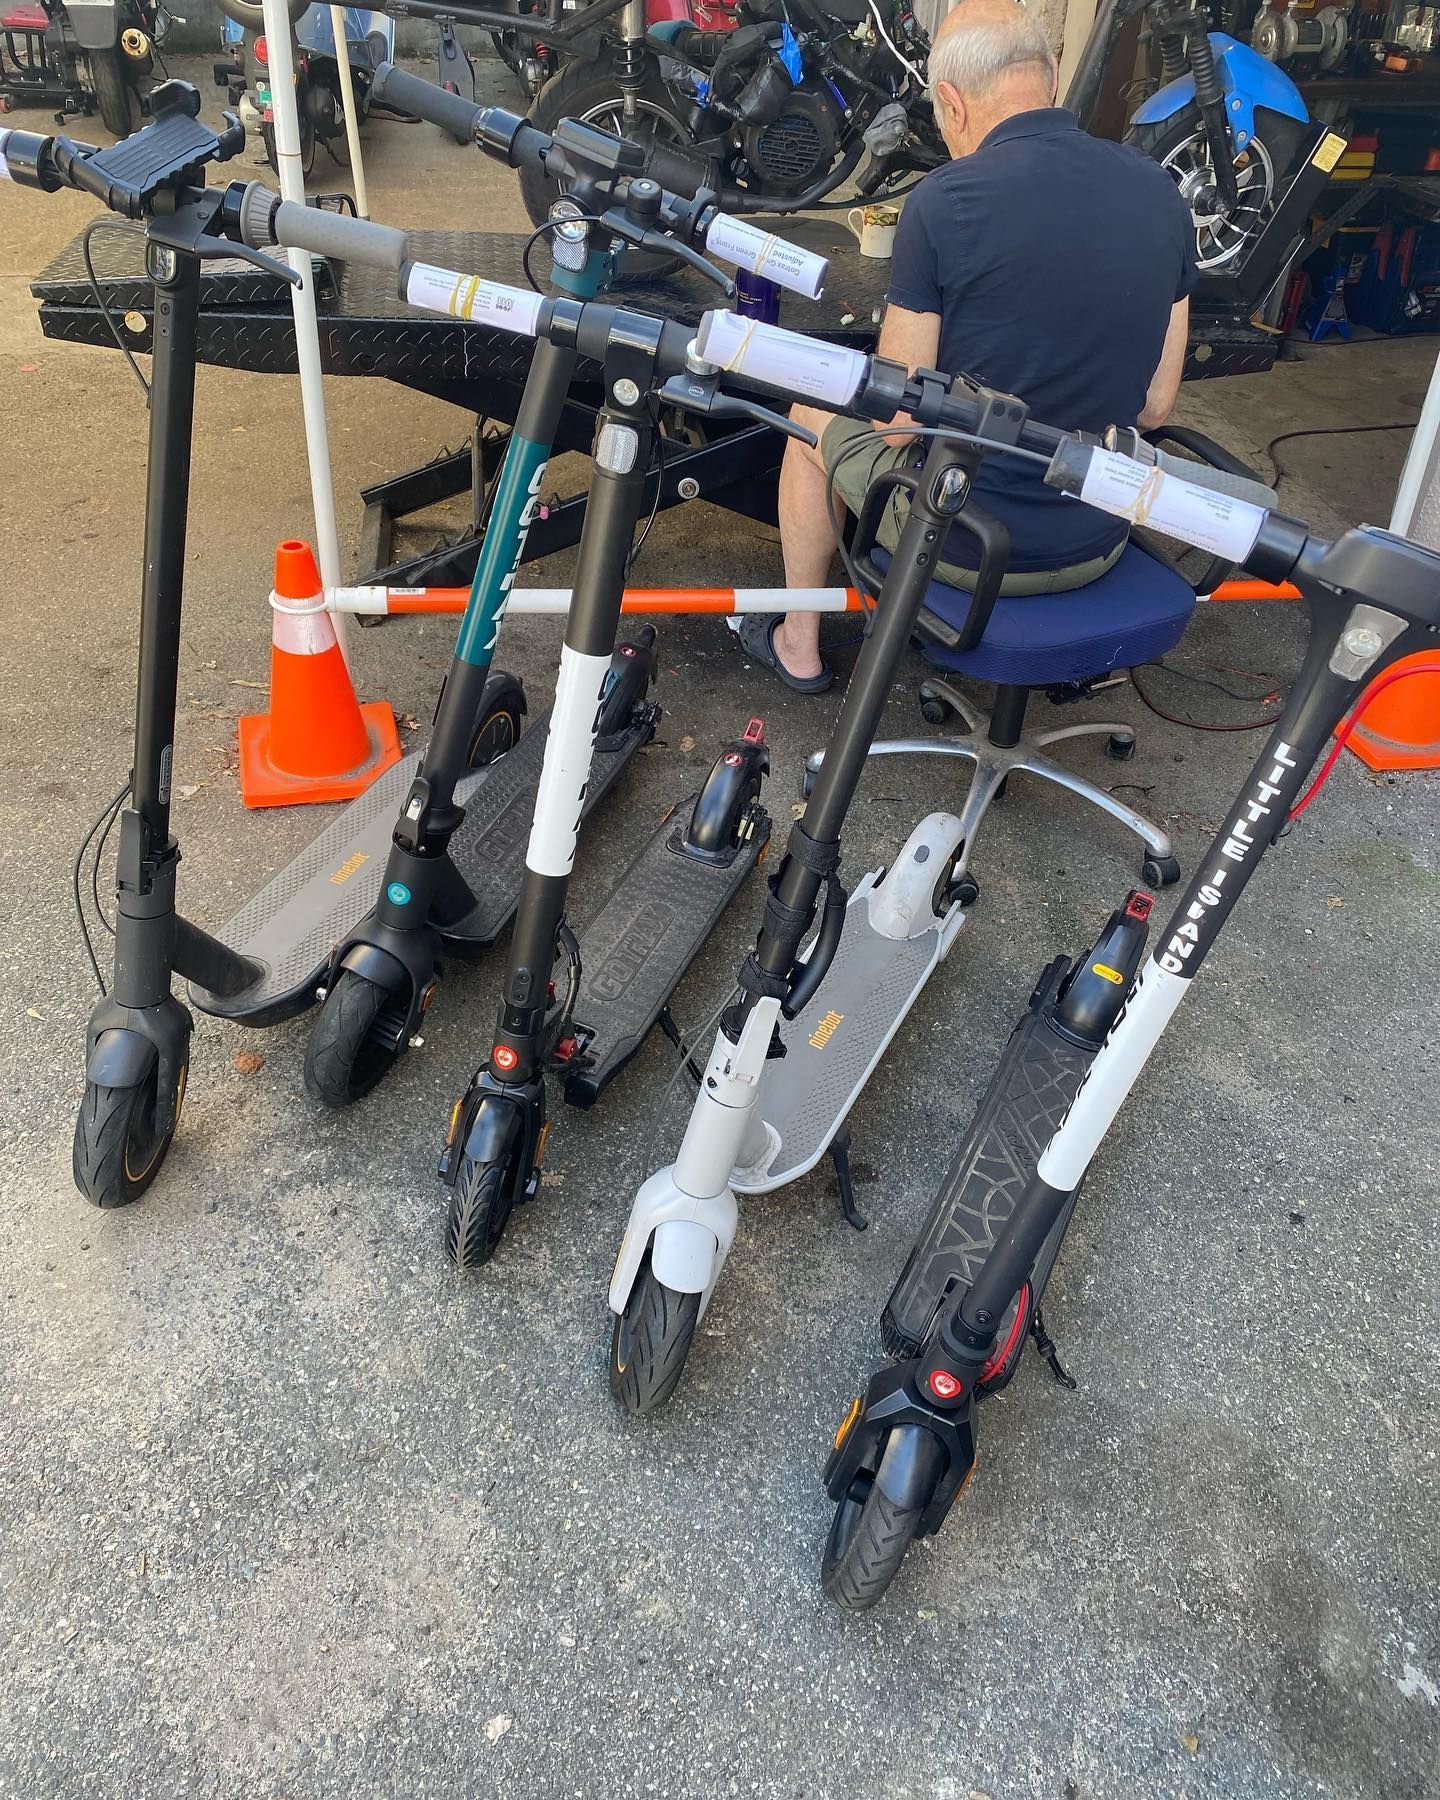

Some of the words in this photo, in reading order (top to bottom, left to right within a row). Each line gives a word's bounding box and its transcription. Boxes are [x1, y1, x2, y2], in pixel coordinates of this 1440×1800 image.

[736, 246, 757, 260] Green
[772, 250, 804, 267] Adjusted
[1221, 741, 1297, 862] LITTLE
[591, 903, 666, 999] GOTRAX
[1159, 868, 1228, 975] ISLAND
[808, 1009, 845, 1050] ninebot
